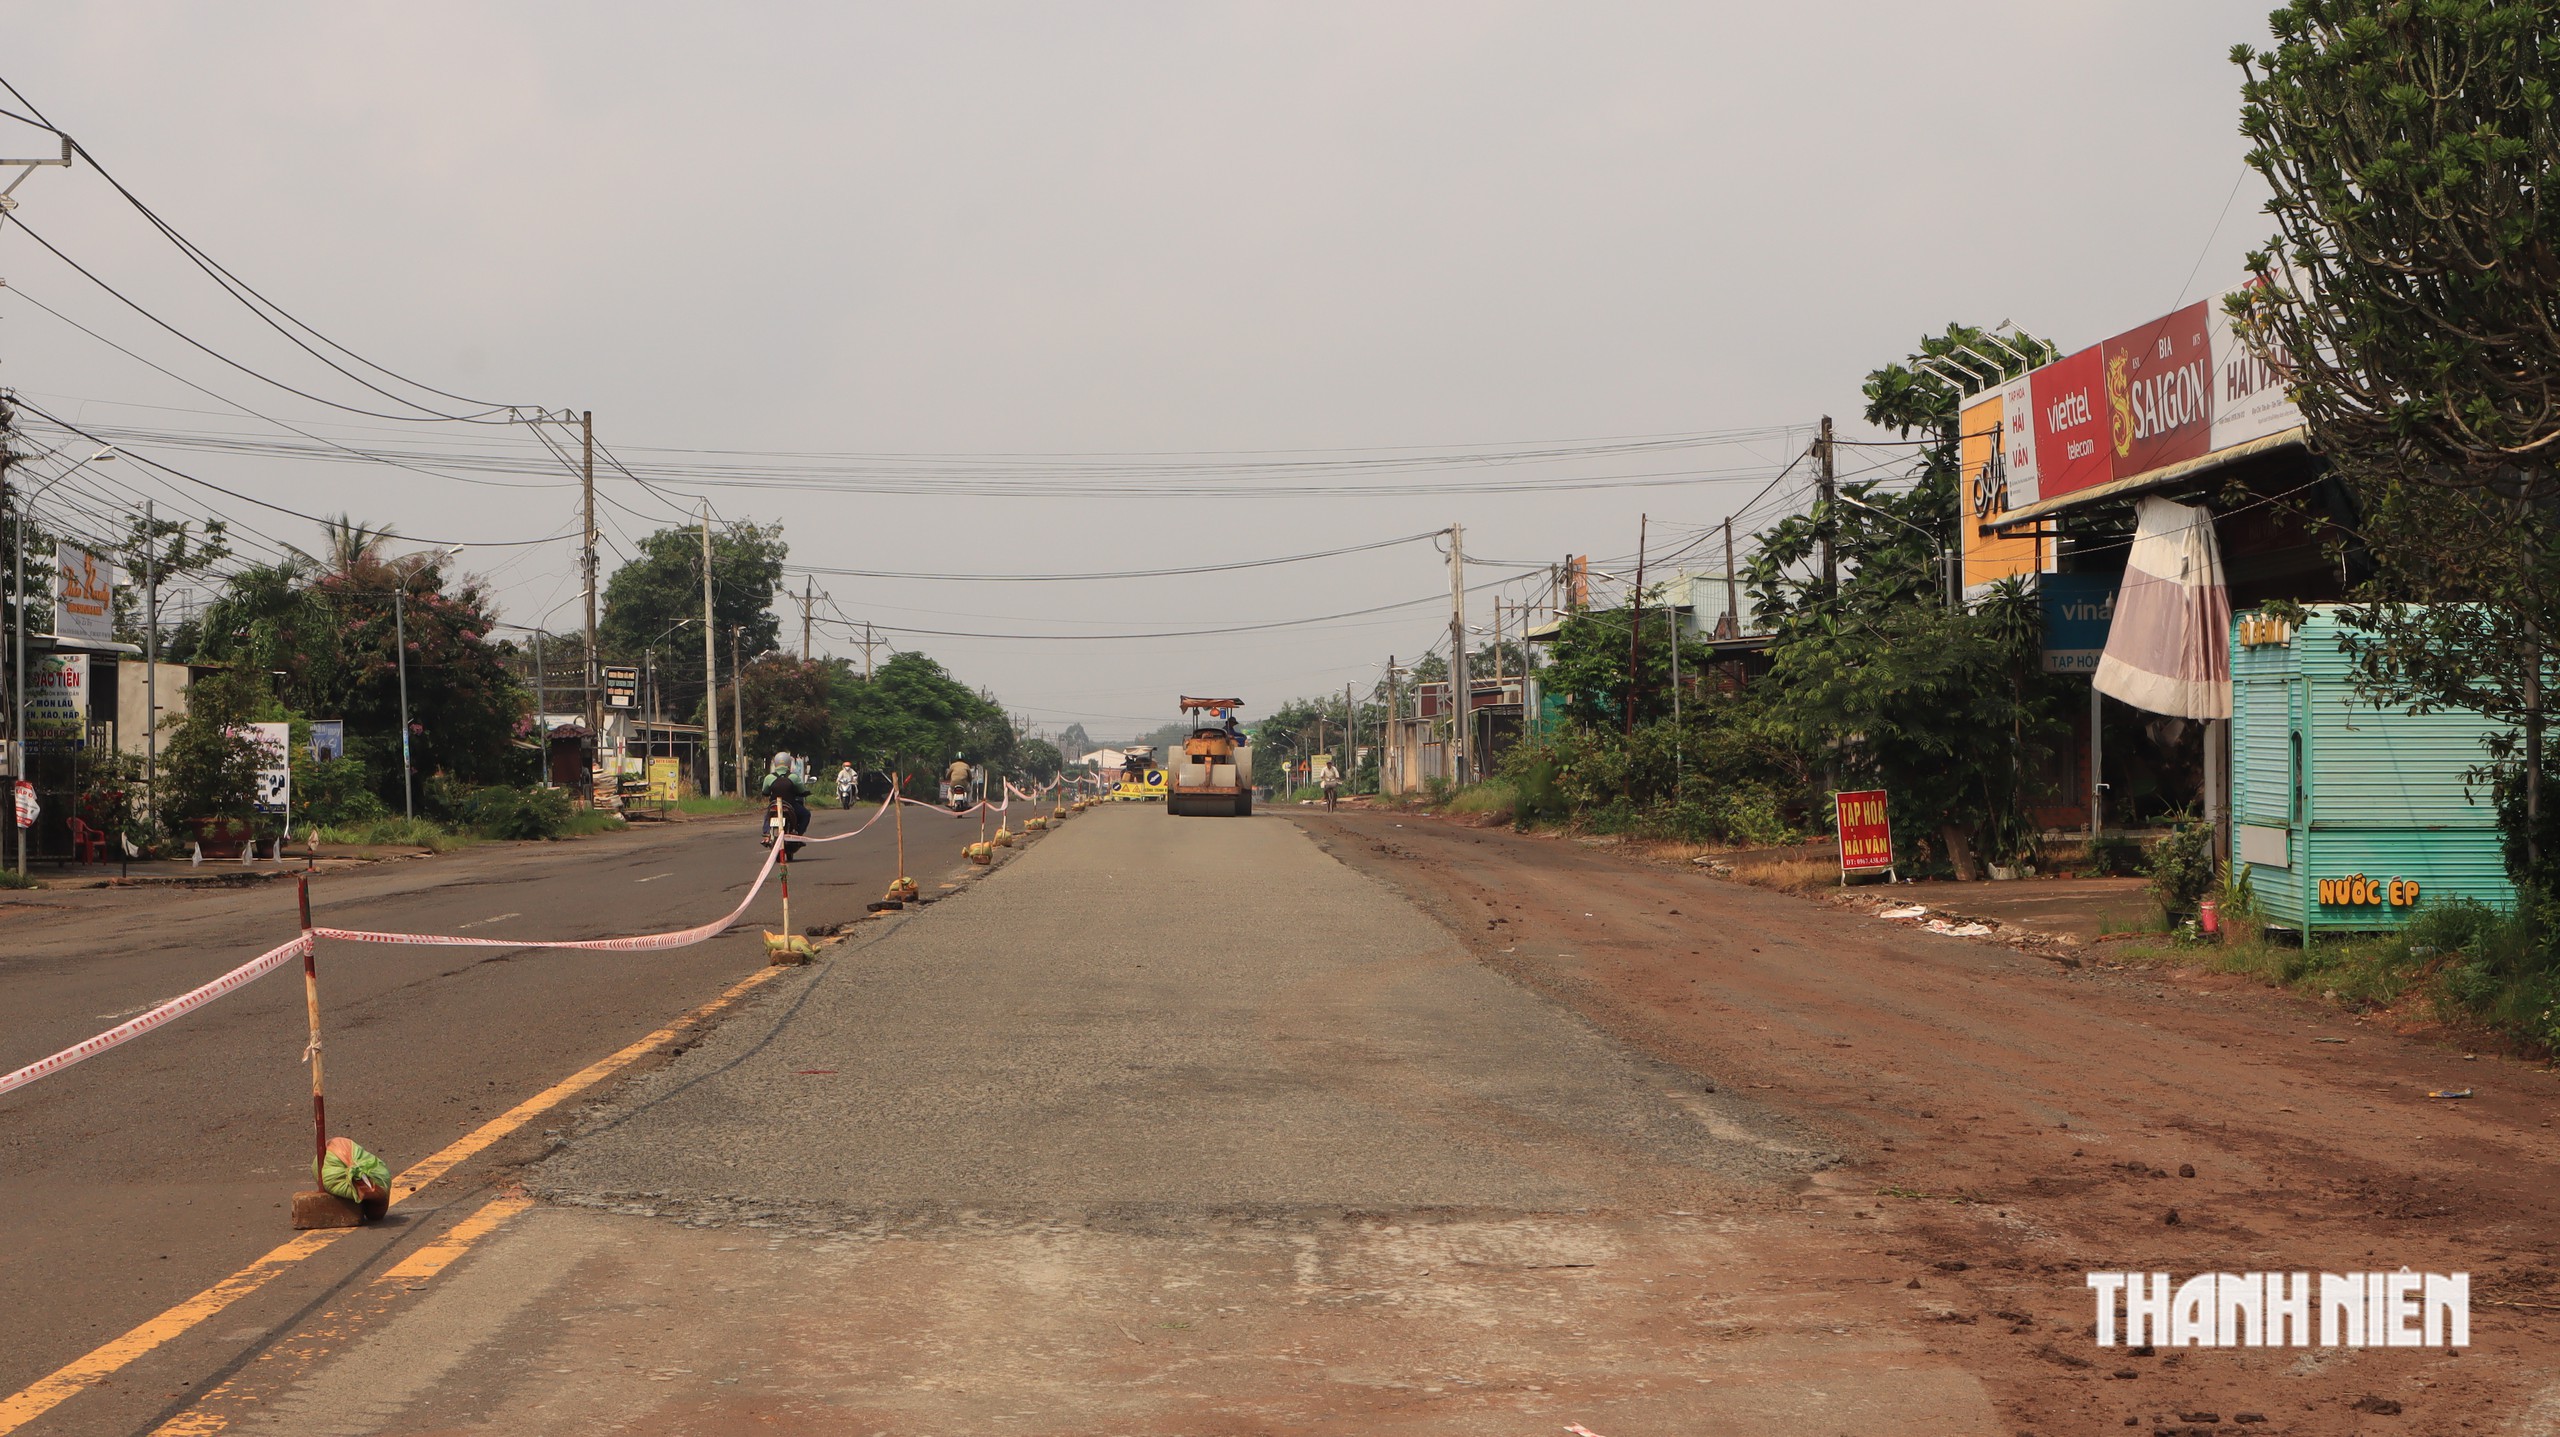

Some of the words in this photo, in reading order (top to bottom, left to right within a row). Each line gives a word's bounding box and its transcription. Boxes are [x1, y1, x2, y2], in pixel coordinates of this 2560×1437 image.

[2159, 336, 2172, 359] BIA
[2227, 346, 2254, 402] HẢI
[2046, 386, 2092, 435] viettel
[2132, 358, 2206, 440] SAIGON
[2012, 408, 2025, 434] HẢI
[2013, 445, 2029, 469] VÂN
[2067, 438, 2095, 461] telecom
[2051, 656, 2074, 671] TẠP
[2077, 652, 2100, 668] HÓA
[1840, 802, 1861, 832] TẠP
[1863, 795, 1885, 826] HÓA
[1844, 834, 1864, 856] HẢI
[1865, 835, 1888, 855] VÂN
[2318, 872, 2382, 906] NƯỚC
[2388, 875, 2421, 907] ÉP
